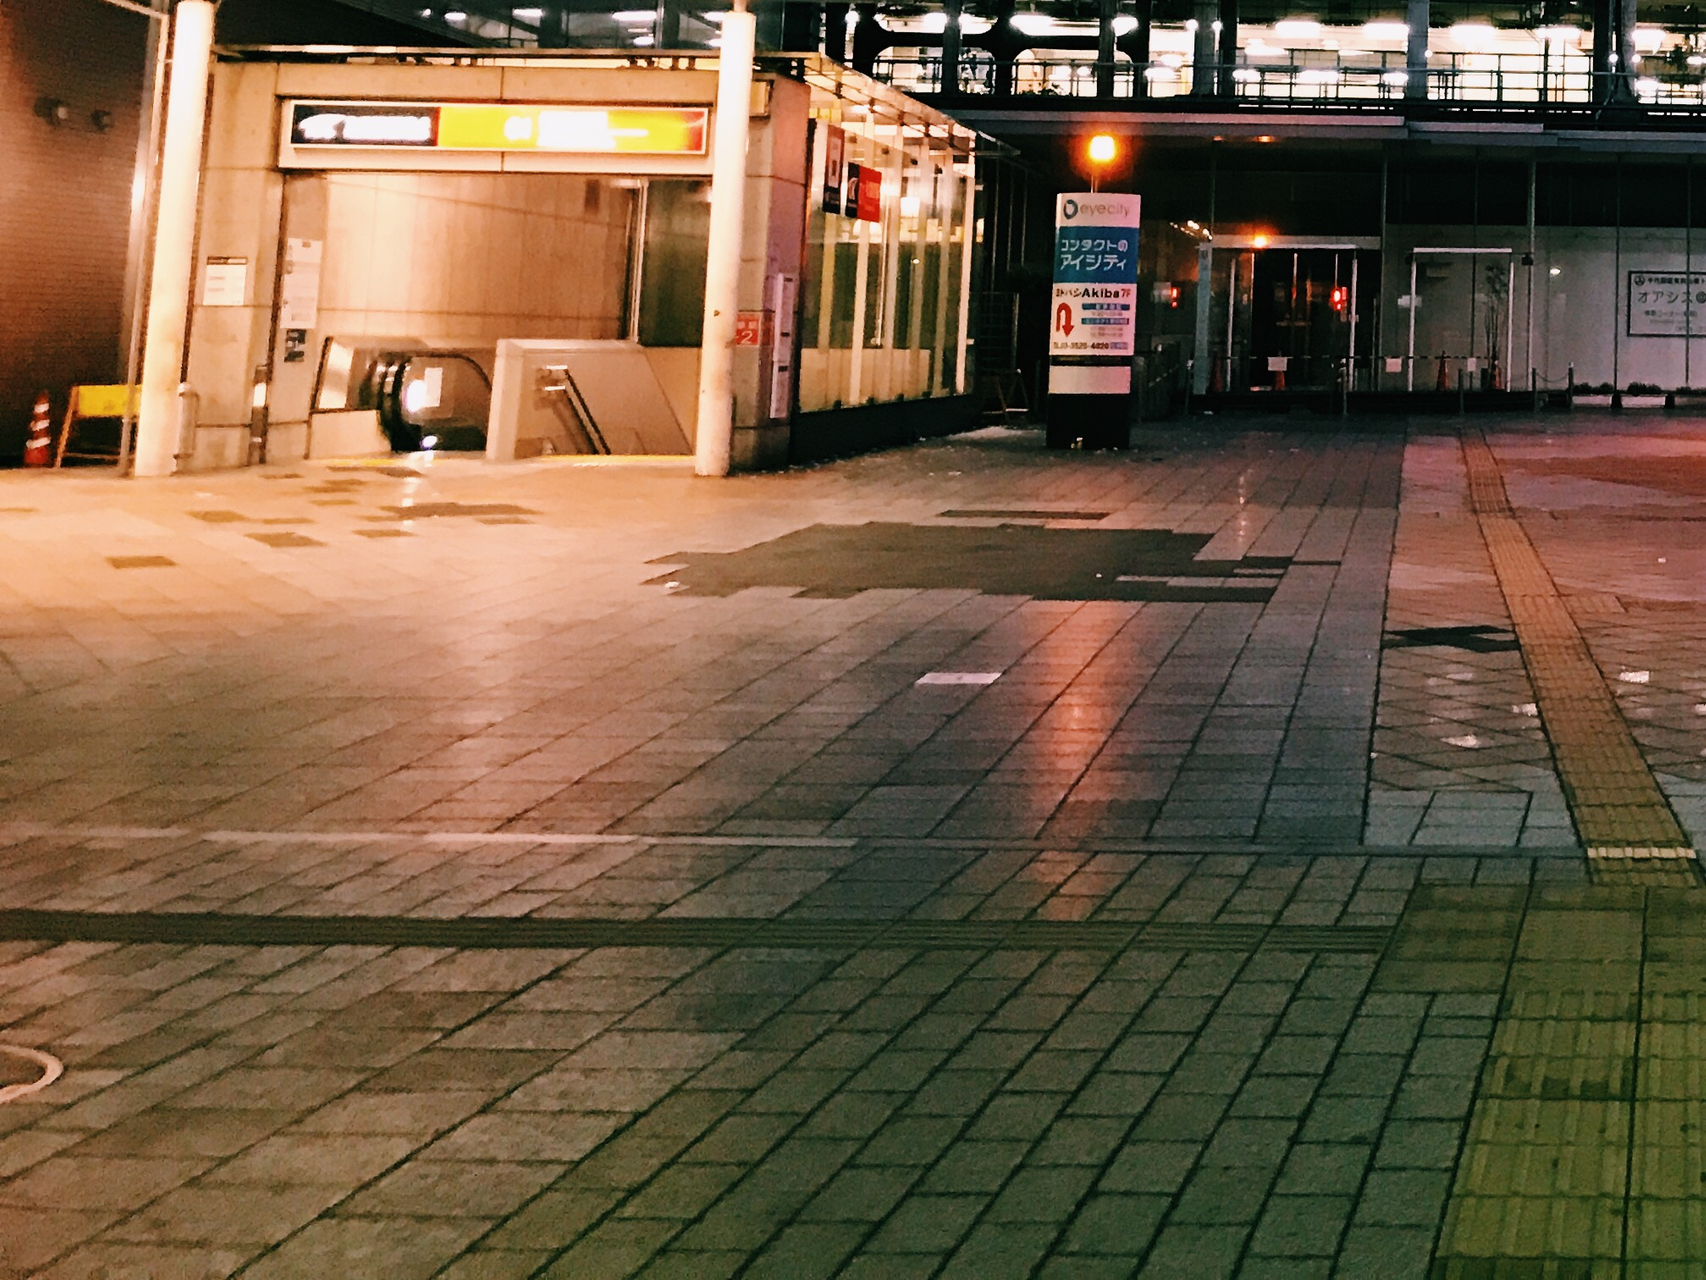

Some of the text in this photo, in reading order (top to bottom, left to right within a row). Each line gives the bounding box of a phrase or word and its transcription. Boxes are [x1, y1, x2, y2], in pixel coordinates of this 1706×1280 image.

[1080, 203, 1130, 217] eyecity
[1061, 239, 1128, 252] コンタクトの
[1060, 254, 1127, 271] アイシティ
